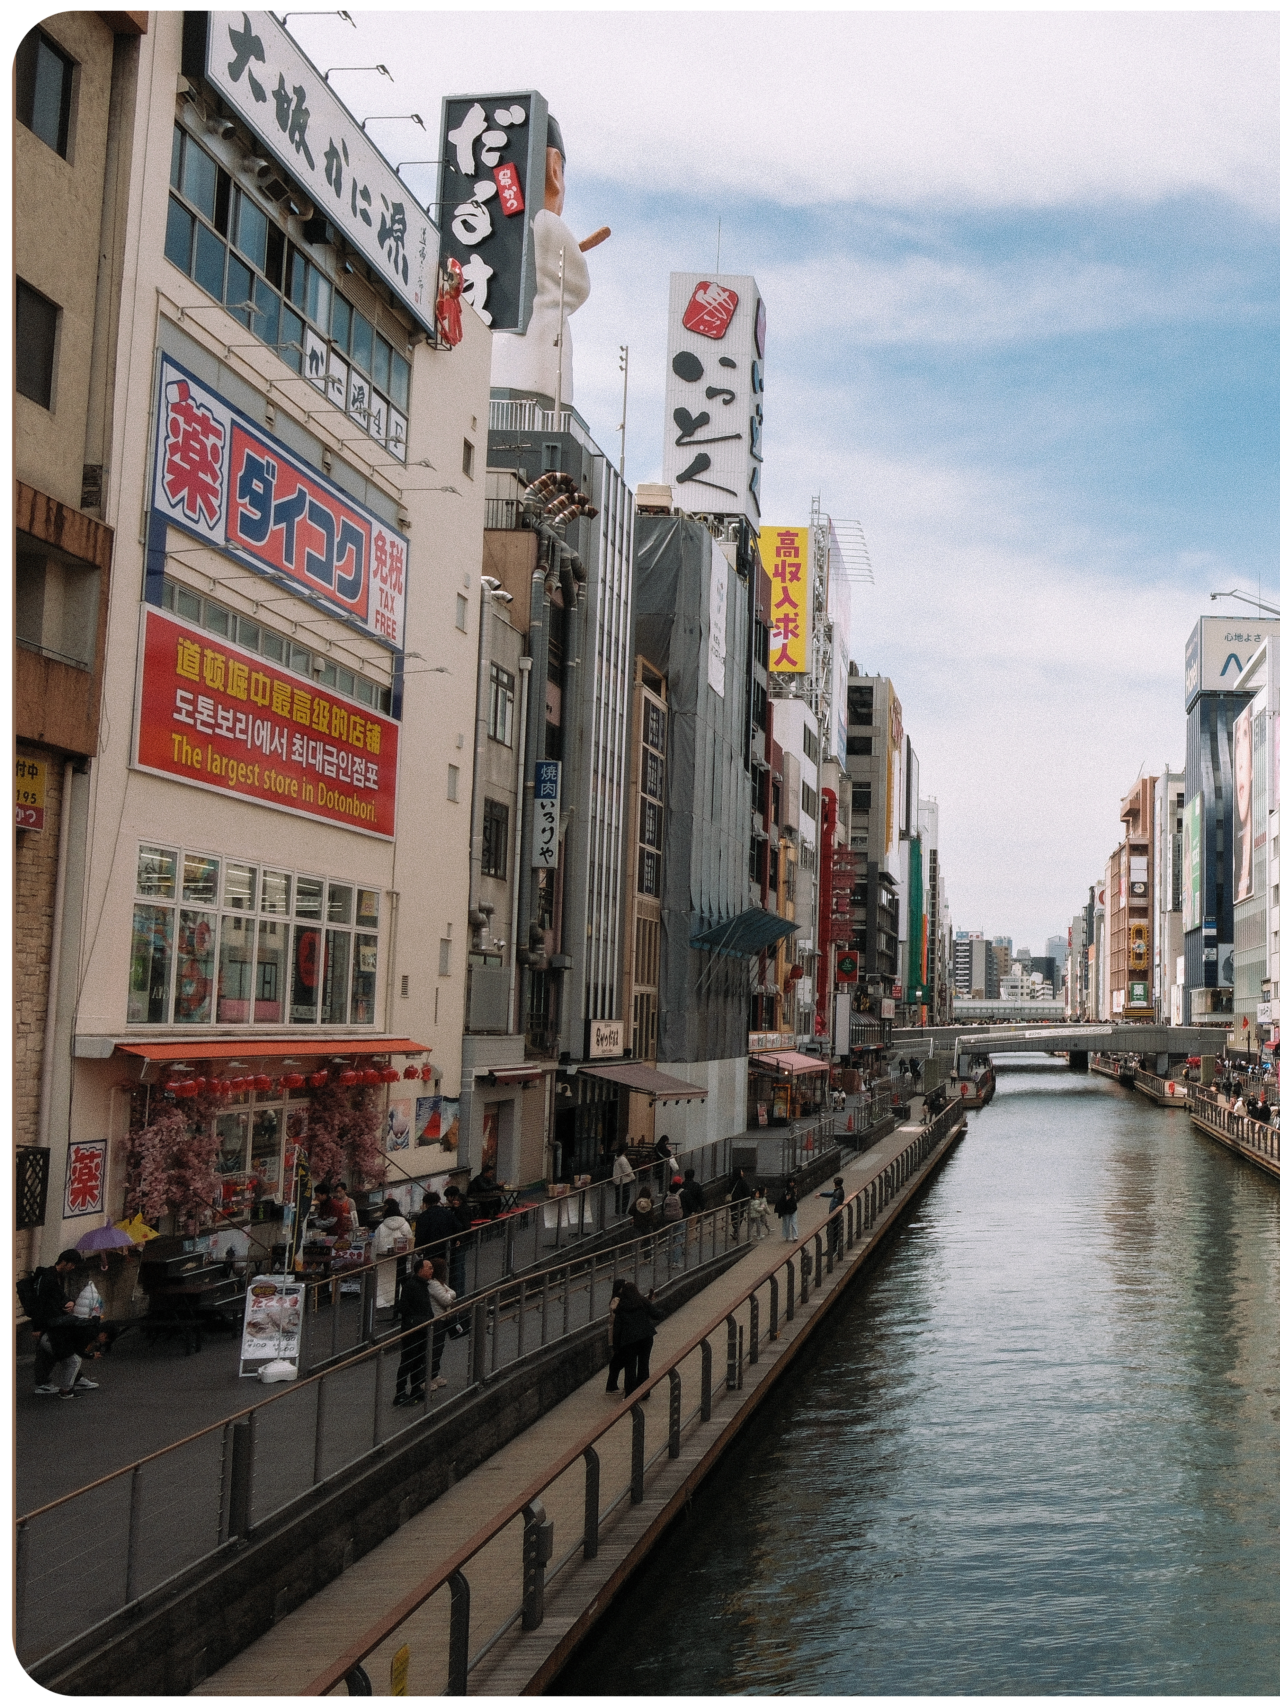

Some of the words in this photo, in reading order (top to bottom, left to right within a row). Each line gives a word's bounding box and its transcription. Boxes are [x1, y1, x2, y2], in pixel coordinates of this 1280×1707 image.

[448, 102, 525, 327] だるま
[498, 168, 520, 212] 串かつ
[165, 395, 224, 523] 薬
[236, 447, 366, 604] ダイコク
[373, 529, 403, 596] 免税
[375, 610, 397, 642] FREE
[379, 590, 395, 616] TAX
[772, 530, 802, 667] 高収入求人
[171, 732, 202, 769] The
[206, 748, 260, 789] largest
[263, 764, 299, 799] store
[301, 775, 315, 802] in
[172, 688, 288, 762] 도톤보리에서
[291, 733, 379, 791] 최대급인점포
[540, 764, 557, 797] 焼肉
[539, 801, 555, 864] いろりや
[67, 1147, 103, 1213] 薬
